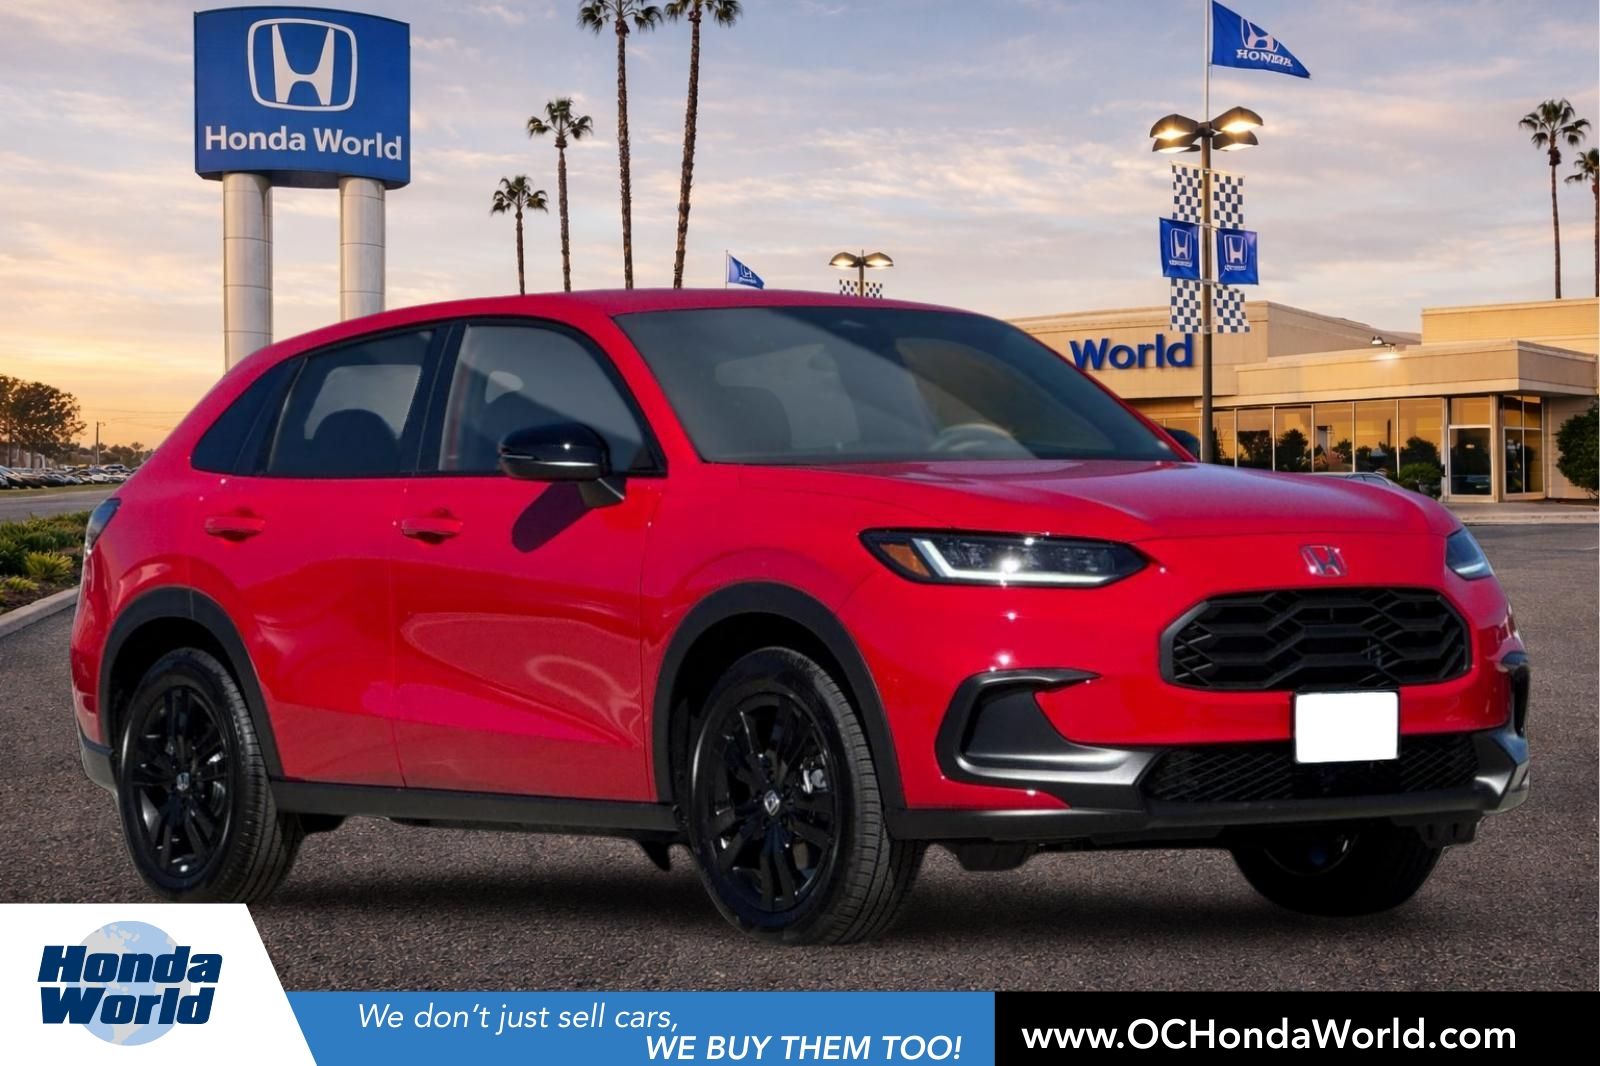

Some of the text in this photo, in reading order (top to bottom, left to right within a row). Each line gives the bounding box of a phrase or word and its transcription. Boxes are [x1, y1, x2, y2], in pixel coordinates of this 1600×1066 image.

[205, 126, 402, 160] Honda World
[1069, 333, 1193, 370] World
